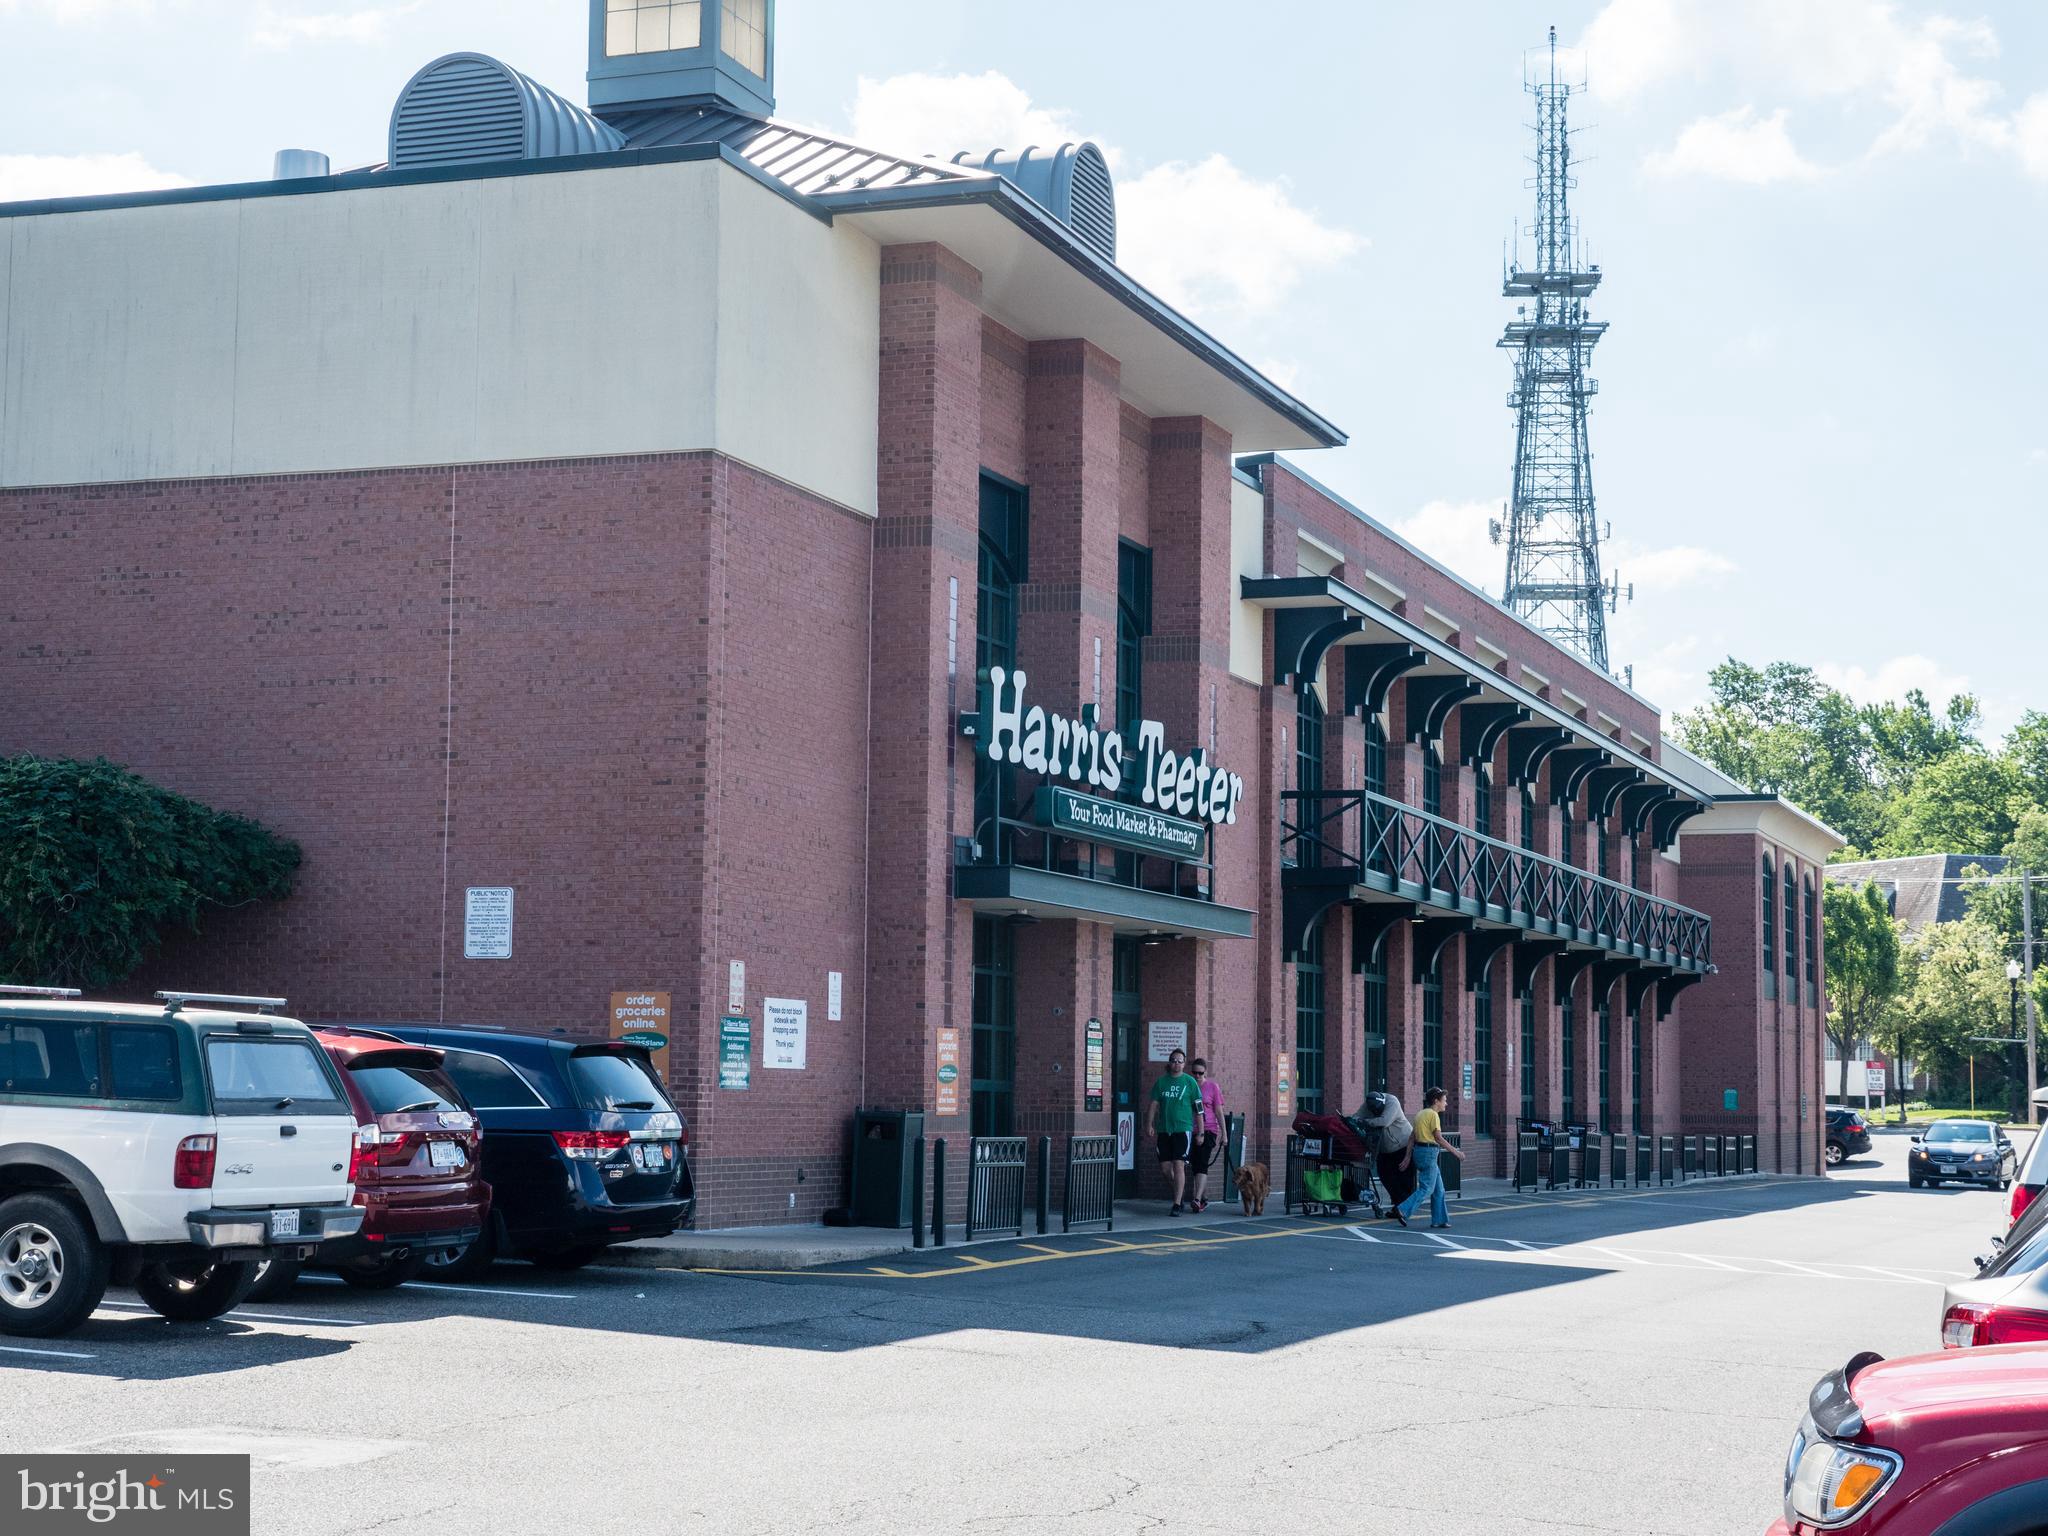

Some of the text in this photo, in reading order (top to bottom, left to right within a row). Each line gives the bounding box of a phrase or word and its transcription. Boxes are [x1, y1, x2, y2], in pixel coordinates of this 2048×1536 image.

[988, 666, 1243, 824] Harris Teeter
[1069, 798, 1197, 850] Your Food Market & Pharmacy
[626, 994, 656, 1004] order
[616, 1006, 666, 1018] groceries
[623, 1018, 657, 1028] online.
[772, 1027, 788, 1036] shopping
[722, 1070, 735, 1078] parking
